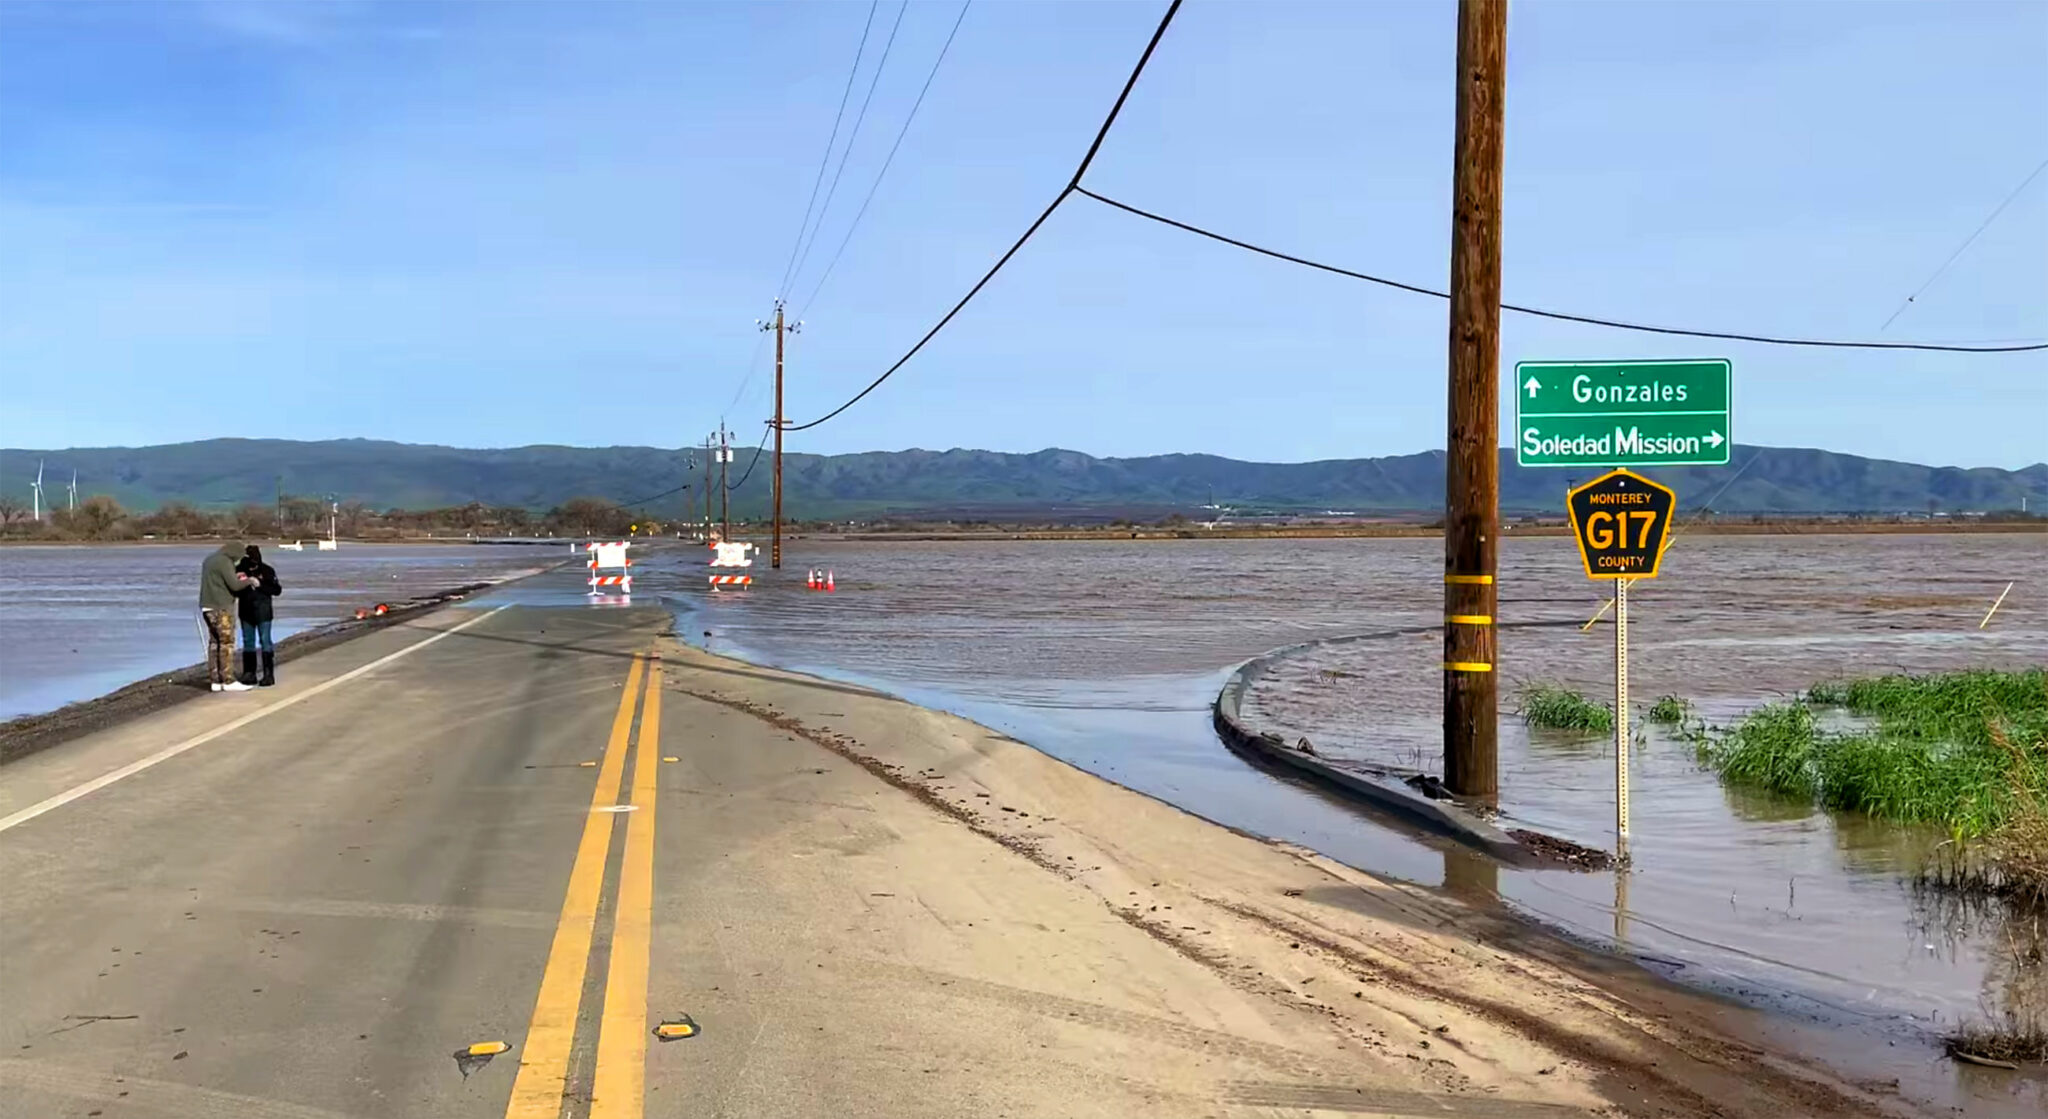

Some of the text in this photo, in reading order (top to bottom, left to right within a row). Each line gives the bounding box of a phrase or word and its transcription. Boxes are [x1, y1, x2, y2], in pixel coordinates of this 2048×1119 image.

[1572, 374, 1688, 403] Gonzales
[1523, 425, 1700, 456] Soledad Mission
[1589, 493, 1652, 504] MONTEREY
[1586, 511, 1657, 550] G17
[1598, 556, 1645, 567] COUNTY
